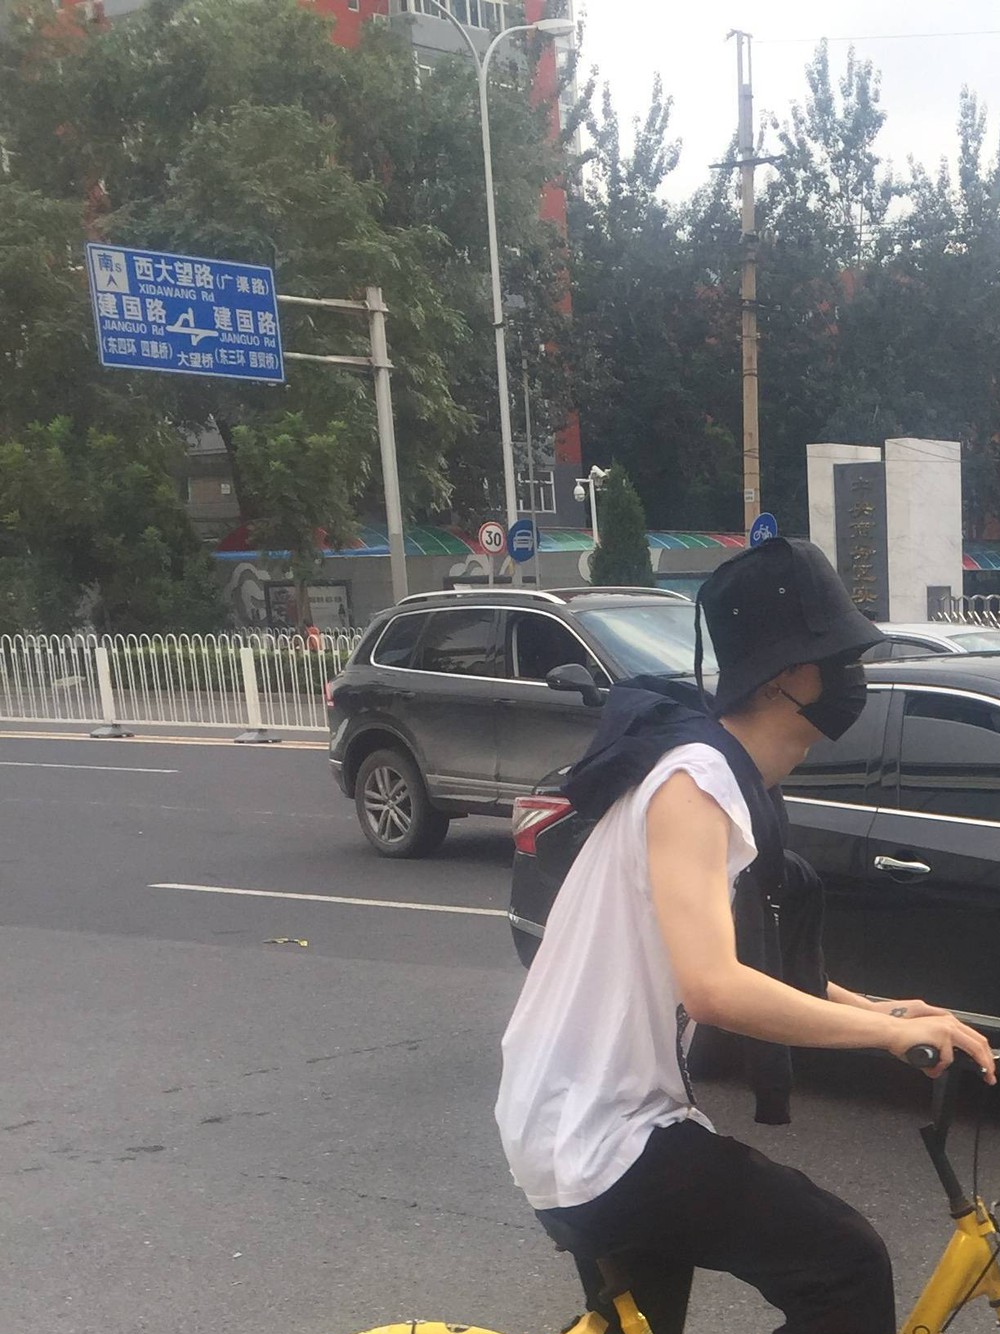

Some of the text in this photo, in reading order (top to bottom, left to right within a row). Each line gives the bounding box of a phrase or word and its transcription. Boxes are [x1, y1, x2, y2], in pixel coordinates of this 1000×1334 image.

[97, 252, 115, 273] 南
[133, 256, 215, 290] 西大望路
[138, 283, 215, 302] XIDAWANG Rd
[97, 292, 167, 325] 建国路
[102, 318, 165, 337] JIANGUO Rd
[213, 305, 276, 336] 建国路
[219, 332, 276, 348] JIANGUO Rd
[485, 530, 502, 547] 30
